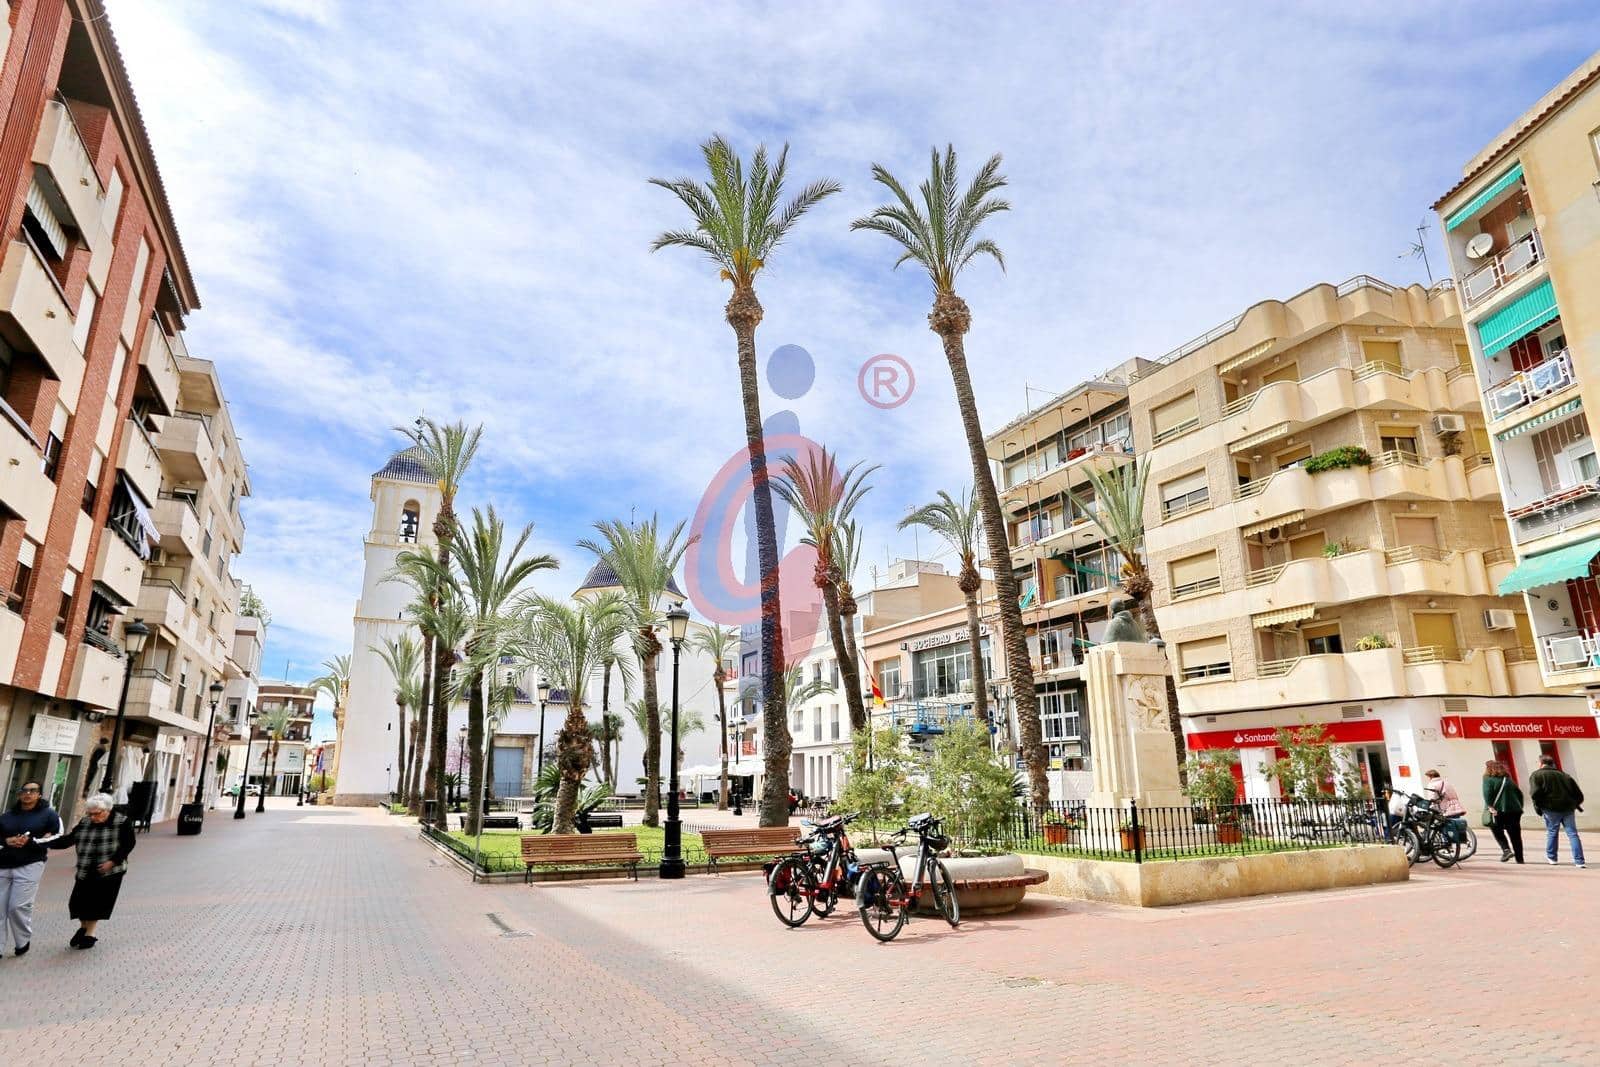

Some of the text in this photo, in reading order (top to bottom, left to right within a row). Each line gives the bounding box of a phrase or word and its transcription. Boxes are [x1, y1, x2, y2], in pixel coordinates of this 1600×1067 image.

[913, 633, 951, 650] SOCIEDAD
[1492, 721, 1585, 735] Santander Agentes
[1244, 731, 1281, 743] Santande
